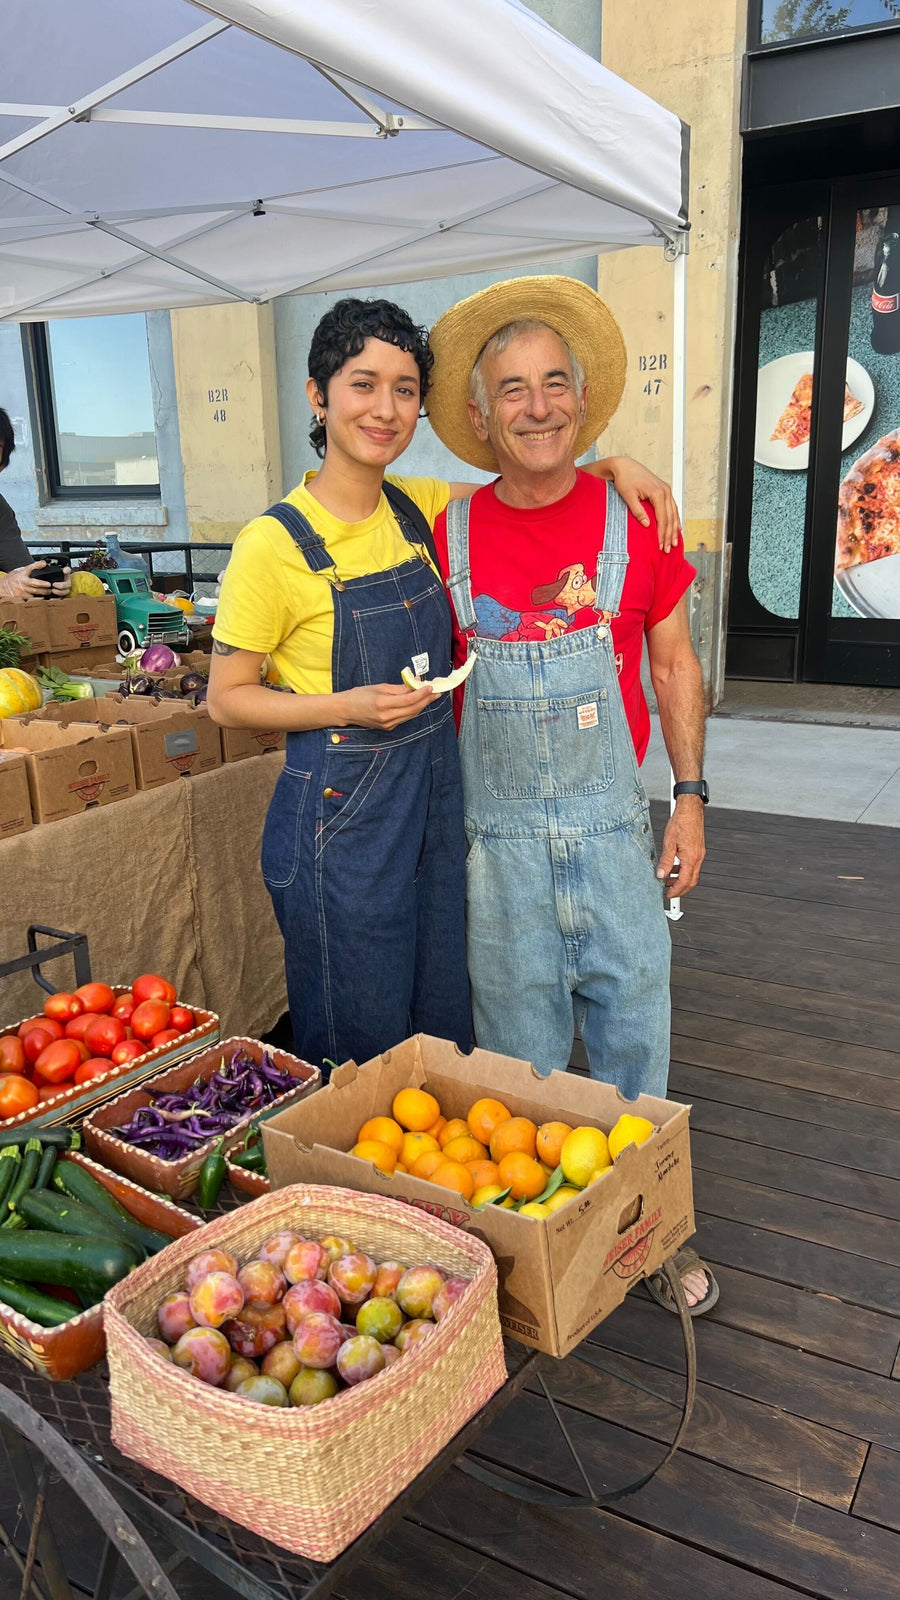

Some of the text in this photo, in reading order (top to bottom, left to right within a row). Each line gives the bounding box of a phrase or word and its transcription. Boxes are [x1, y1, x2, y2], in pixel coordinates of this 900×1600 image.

[643, 379, 662, 395] 47
[213, 409, 226, 422] 48
[634, 1206, 662, 1239] FAMILY
[500, 1316, 539, 1340] WEISER
